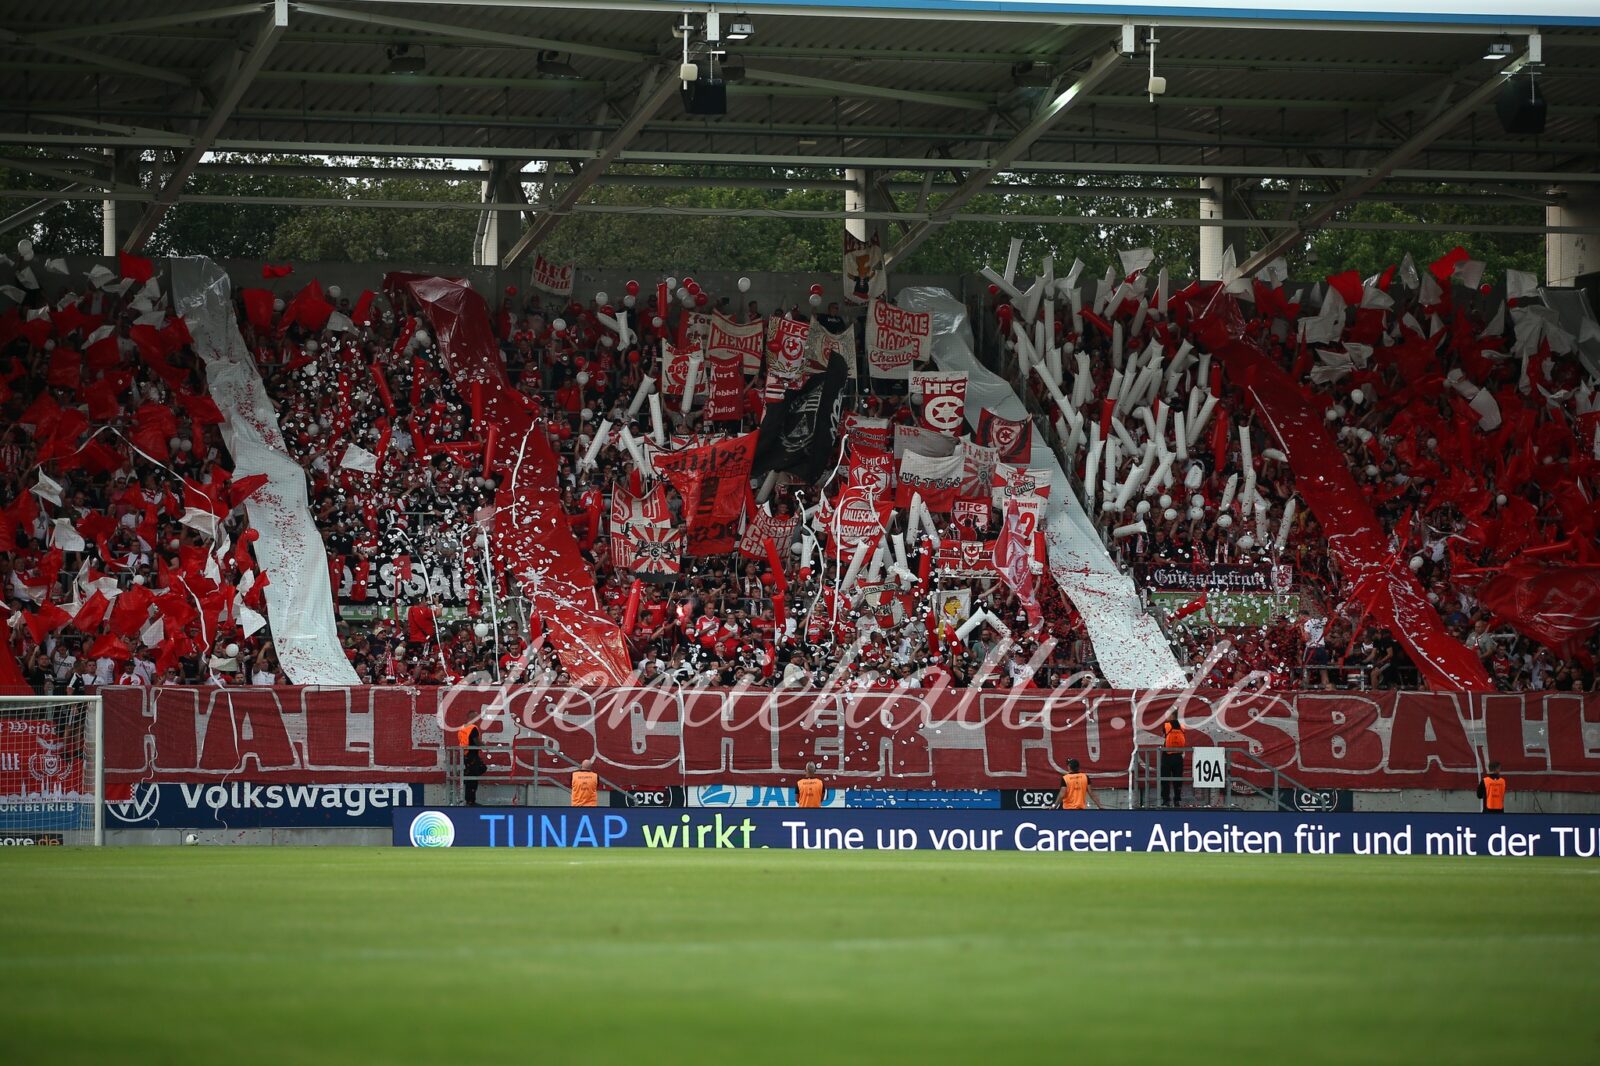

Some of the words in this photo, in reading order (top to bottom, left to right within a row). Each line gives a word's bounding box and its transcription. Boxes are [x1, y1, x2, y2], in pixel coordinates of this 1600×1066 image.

[875, 300, 930, 336] CHEMIE
[711, 323, 763, 357] CHEMIE
[780, 321, 811, 338] HFC
[925, 382, 966, 395] HFC
[901, 471, 961, 490] ULTRAS
[958, 502, 982, 513] HFC
[102, 686, 933, 777] HALLESCHER
[983, 690, 1600, 778] FUSSBALL
[1195, 760, 1224, 783] 19A
[180, 783, 413, 816] Volkswagen
[633, 791, 664, 806] CFC
[1022, 792, 1054, 806] CFC
[480, 814, 628, 848] TUNAP
[782, 821, 865, 851] Tune
[1014, 822, 1133, 852] Career:
[1146, 822, 1283, 855] Arbeiten
[1295, 824, 1341, 855] für
[1353, 825, 1413, 856] und
[1426, 825, 1477, 856] mit
[1489, 826, 1541, 857] der
